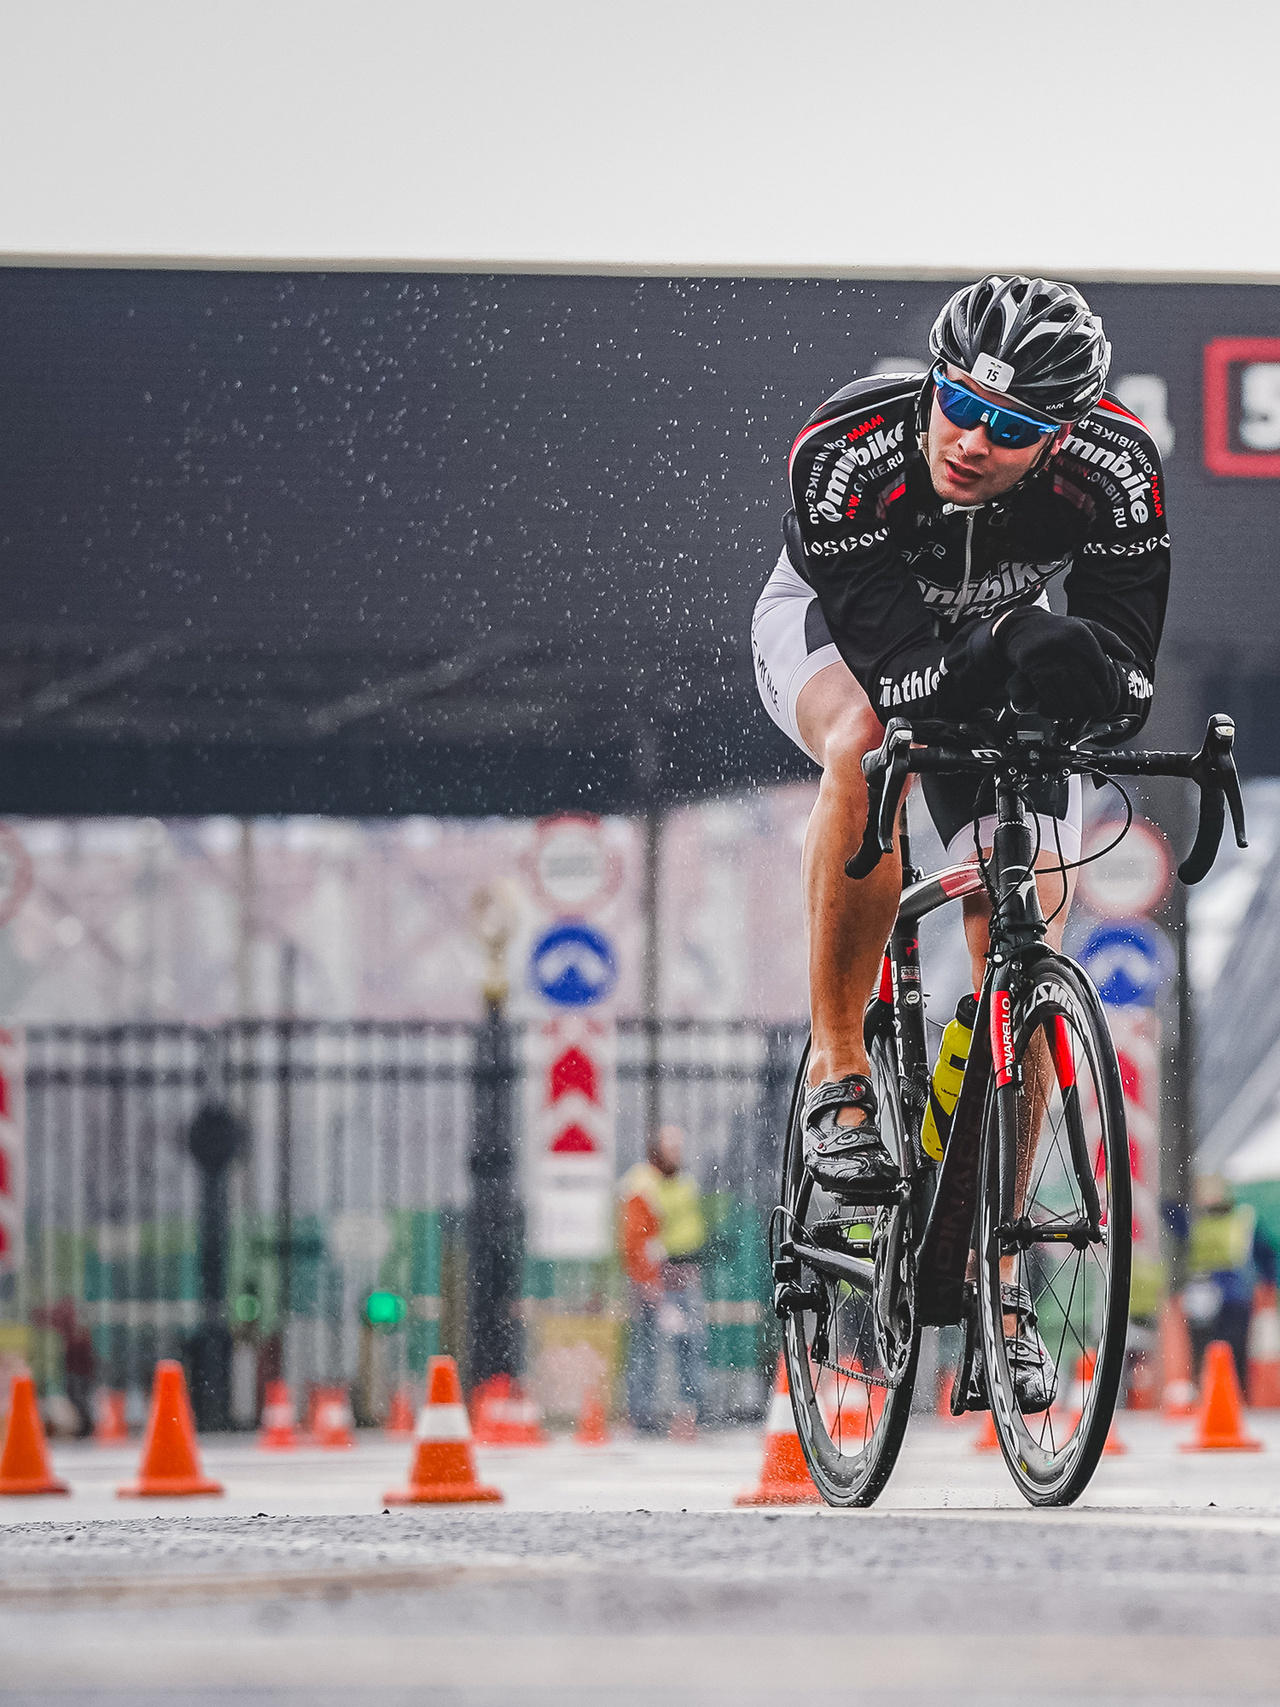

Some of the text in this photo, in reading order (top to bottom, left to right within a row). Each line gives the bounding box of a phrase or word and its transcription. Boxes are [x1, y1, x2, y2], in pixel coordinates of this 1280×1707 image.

[986, 368, 999, 382] 15
[1060, 434, 1151, 524] mnibike
[1083, 533, 1171, 556] MOSCO
